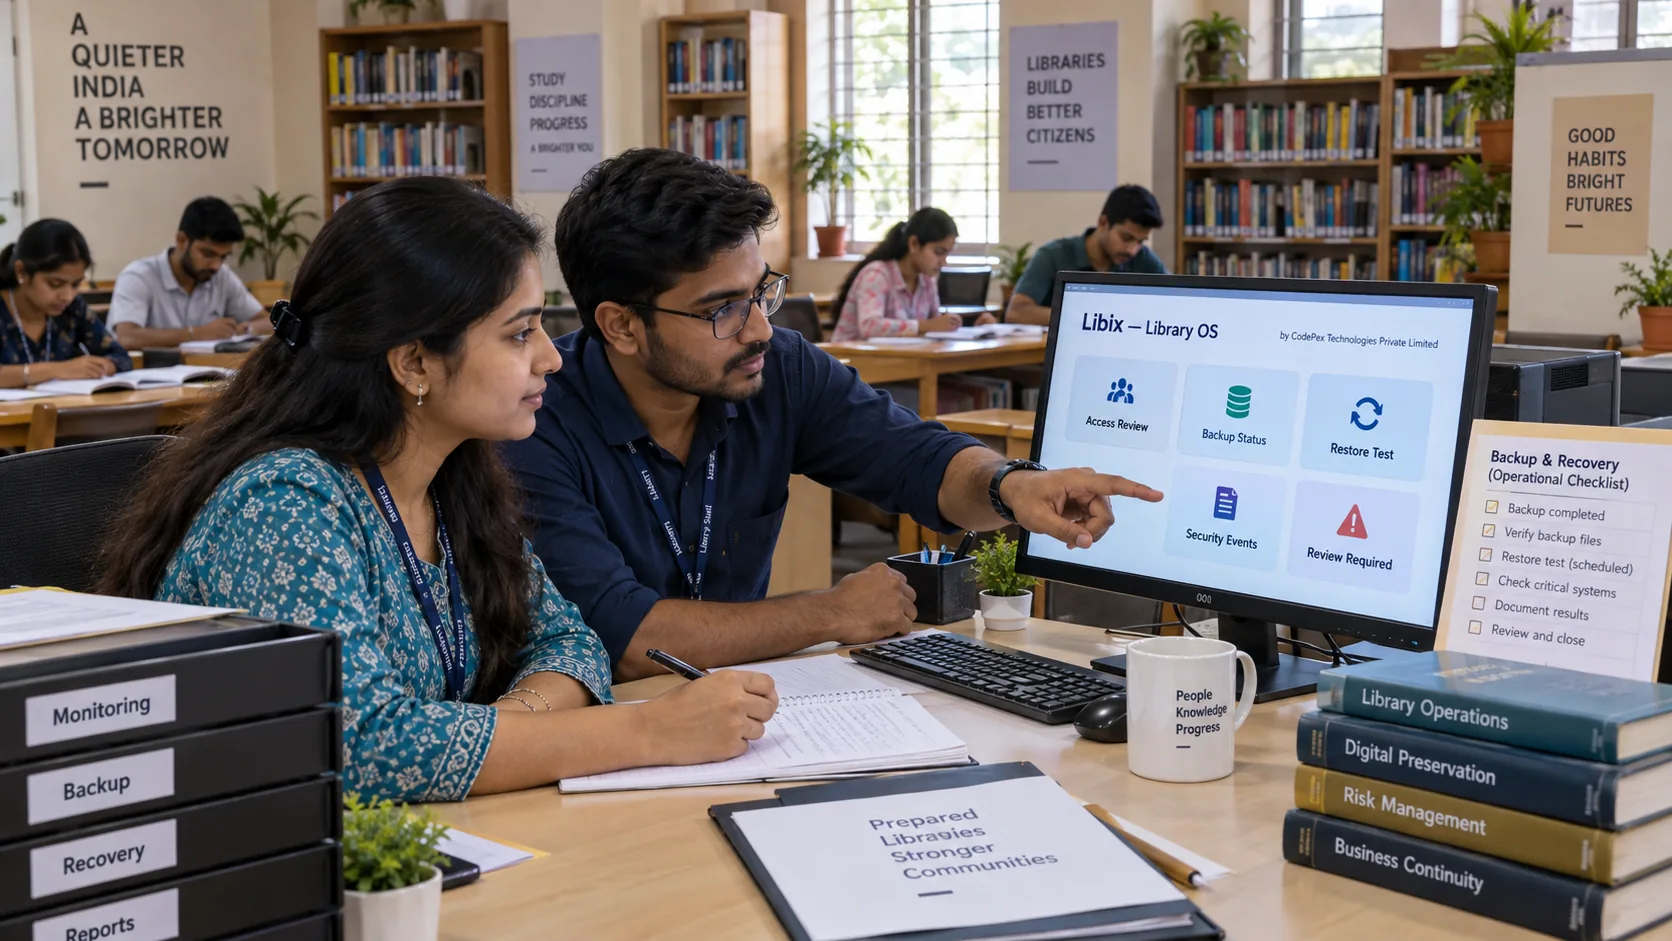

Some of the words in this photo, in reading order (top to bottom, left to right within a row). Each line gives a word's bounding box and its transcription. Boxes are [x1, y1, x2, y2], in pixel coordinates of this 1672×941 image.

[70, 12, 88, 35] A
[72, 43, 185, 69] QUIETER
[1027, 53, 1106, 72] LIBRARIES
[73, 75, 145, 98] INDIA
[529, 72, 566, 87] STUDY
[1027, 79, 1073, 96] BUILD
[529, 93, 588, 109] DISCIPLINE
[1027, 103, 1083, 120] BETTER
[75, 107, 92, 129] A
[100, 106, 223, 129] BRIGHTER
[530, 116, 588, 131] PROGRESS
[1026, 127, 1095, 144] CITIZENS
[1568, 127, 1616, 143] GOOD
[75, 136, 229, 161] TOMORROW
[530, 143, 536, 154] A
[538, 143, 575, 153] BRIGHTER
[577, 142, 594, 152] YOU
[1567, 150, 1627, 167] HABITS
[1567, 173, 1626, 189] BRIGHT
[1565, 197, 1633, 213] FUTURES
[1082, 312, 1124, 333] Libix
[1145, 320, 1194, 341] Library
[1197, 323, 1219, 339] OS
[1279, 331, 1289, 341] by
[1291, 331, 1325, 342] CodePex
[1327, 333, 1377, 347] Technologies
[1379, 336, 1406, 347] Private
[1408, 338, 1439, 349] Limited
[1085, 415, 1115, 428] Access
[1117, 419, 1149, 432] Review
[1202, 428, 1235, 443] Backup
[1238, 433, 1267, 446] Status
[1330, 442, 1370, 458] Restore
[1372, 447, 1394, 460] Test
[1491, 450, 1538, 467] Backup
[1542, 453, 1553, 467] &
[1557, 454, 1620, 474] Recovery
[1488, 468, 1563, 486] (Operational
[1567, 474, 1629, 493] Checklist)
[1508, 502, 1546, 517] Backup
[1548, 507, 1605, 522] completed
[1186, 528, 1224, 546] Security
[1226, 534, 1258, 550] Events
[1504, 526, 1535, 543] Verify
[1537, 531, 1576, 547] backup
[1579, 533, 1602, 547] files
[1307, 546, 1343, 563] Review
[1346, 553, 1393, 570] Required
[1501, 551, 1542, 566] Restore
[1545, 556, 1565, 568] test
[1568, 557, 1633, 577] (scheduled)
[1498, 574, 1531, 589] Check
[1533, 580, 1569, 594] critical
[1572, 584, 1617, 599] systems
[1494, 599, 1549, 617] Document
[1553, 608, 1589, 621] results
[1491, 623, 1529, 640] Review
[1532, 631, 1553, 642] and
[1556, 633, 1586, 647] close
[1176, 688, 1213, 703] People
[52, 697, 151, 726] Monitoring
[1176, 704, 1228, 718] Knowledge
[1361, 688, 1416, 717] Library
[1420, 699, 1509, 731] Operations
[1176, 723, 1220, 737] Progress
[1344, 738, 1394, 764] Digital
[1398, 752, 1497, 787] Preservation
[63, 776, 131, 801] Backup
[869, 808, 979, 831] Prepared
[1343, 786, 1376, 810] Risk
[1381, 795, 1487, 837] Management
[63, 844, 146, 875] Recovery
[891, 844, 995, 864] Stronger
[903, 853, 1059, 880] Communities
[1334, 837, 1399, 869] Business
[1403, 856, 1485, 896] Continuity
[65, 916, 135, 941] Reports
